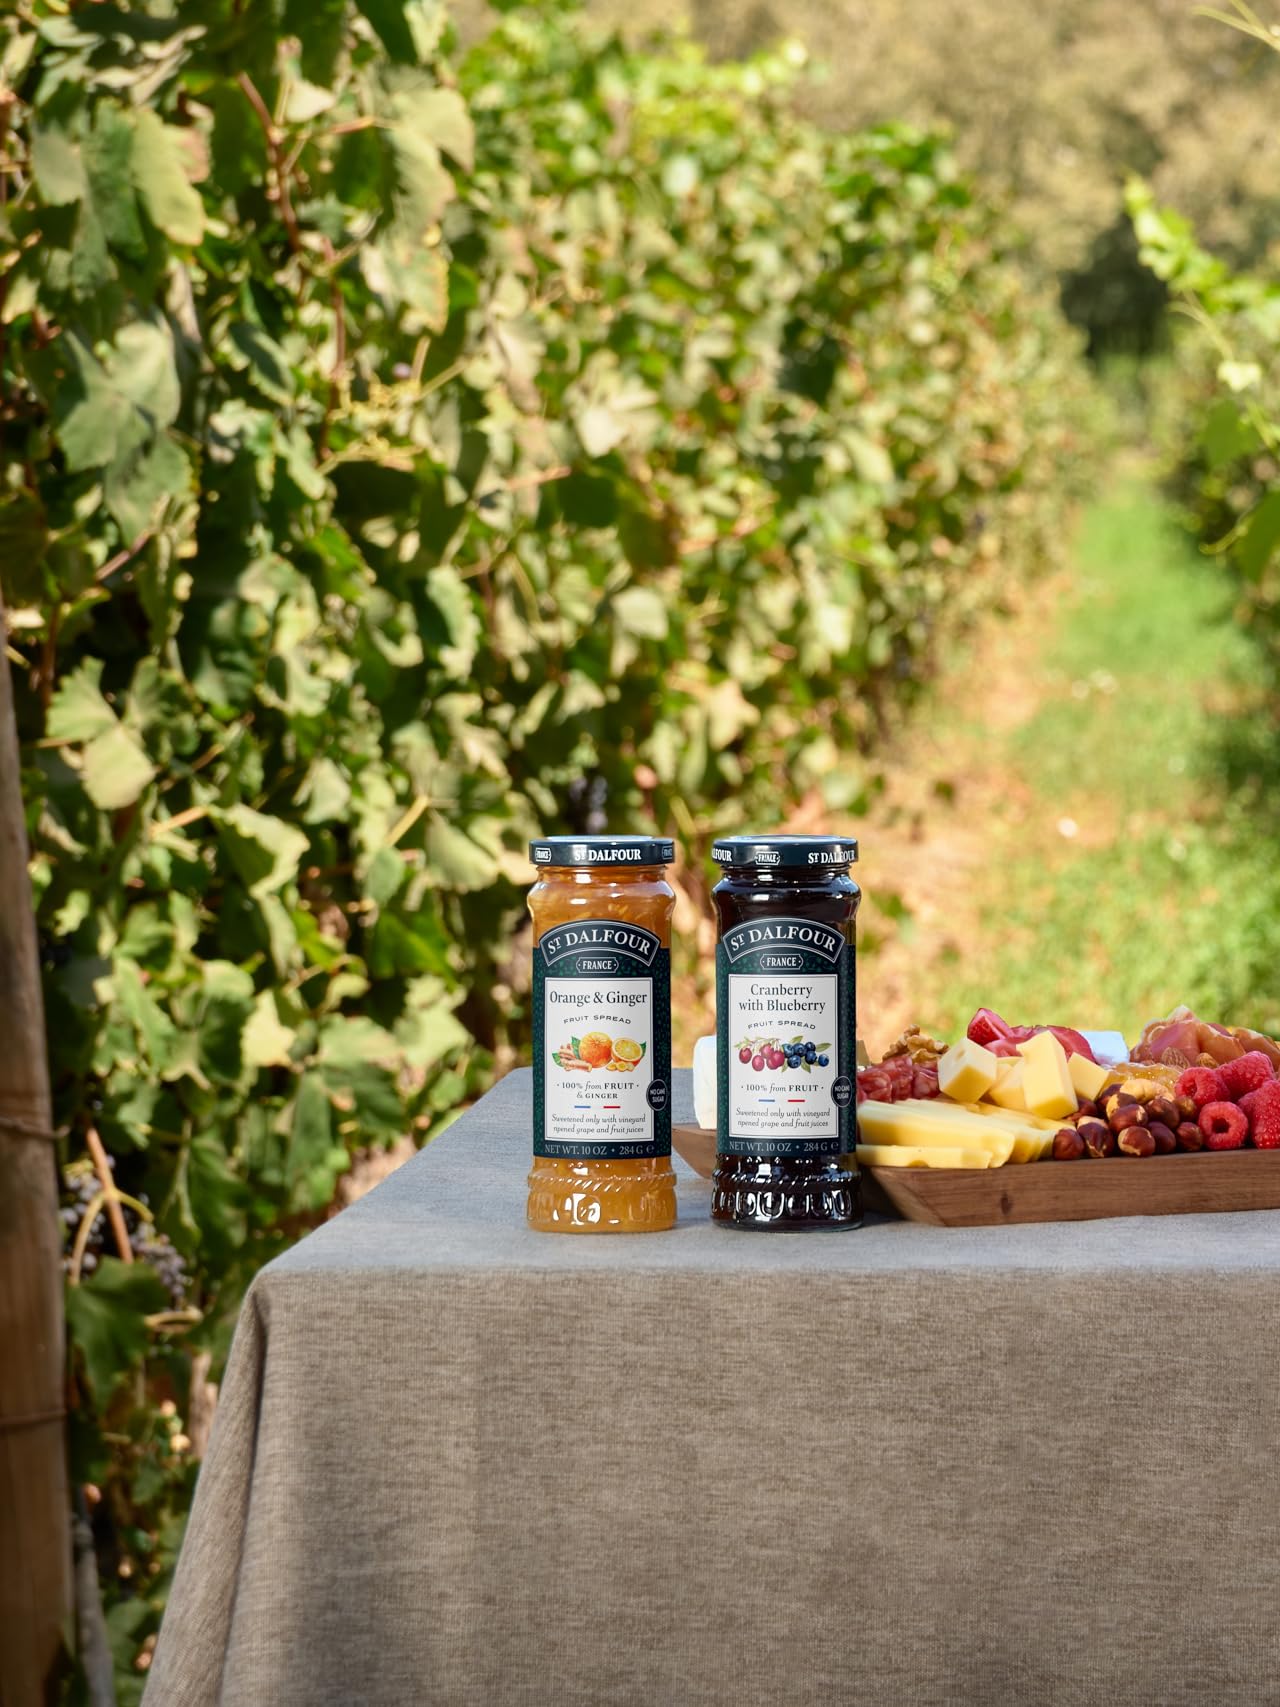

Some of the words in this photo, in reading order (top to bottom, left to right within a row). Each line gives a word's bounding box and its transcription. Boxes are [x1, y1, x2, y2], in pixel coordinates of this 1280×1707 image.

[588, 849, 642, 861] DALFOUR
[565, 929, 651, 956] DALFOUR
[750, 926, 836, 952] DALFOUR
[582, 960, 612, 970] FRANCE
[767, 957, 796, 967] FRANCE
[750, 984, 813, 998] Cranberry
[550, 990, 590, 1007] Orange
[593, 991, 604, 1003] &
[606, 991, 647, 1007] Ginger
[739, 999, 763, 1011] with
[767, 999, 826, 1014] Blueberry
[564, 1015, 589, 1024] FRUIT
[594, 1015, 631, 1024] SPREAD
[748, 1020, 773, 1029] FRUIT
[778, 1020, 816, 1029] SPREAD
[585, 1081, 602, 1091] from
[769, 1083, 786, 1093] from
[736, 1108, 768, 1116] Sweetened
[770, 1108, 785, 1118] only
[786, 1108, 801, 1116] with
[803, 1108, 830, 1118] vineyard
[552, 1114, 584, 1122] Sweetened
[586, 1114, 600, 1124] only
[602, 1114, 617, 1123] with
[618, 1114, 646, 1124] vineyard
[780, 1118, 794, 1127] and
[794, 1118, 809, 1128] fruit
[810, 1120, 828, 1128] juices
[577, 1127, 594, 1135] grape
[596, 1124, 609, 1133] and
[610, 1124, 625, 1135] fruit
[626, 1126, 644, 1134] juices
[545, 1144, 560, 1153] NET
[562, 1146, 580, 1155] WT.
[581, 1146, 588, 1154] 10
[592, 1146, 607, 1155] OZ
[619, 1145, 634, 1155] 284
[636, 1145, 643, 1154] G
[729, 1141, 745, 1150] NET
[746, 1142, 764, 1152] WT.
[766, 1143, 775, 1151] 10
[777, 1142, 791, 1152] OZ
[803, 1142, 819, 1151] 284
[821, 1142, 828, 1151] G
